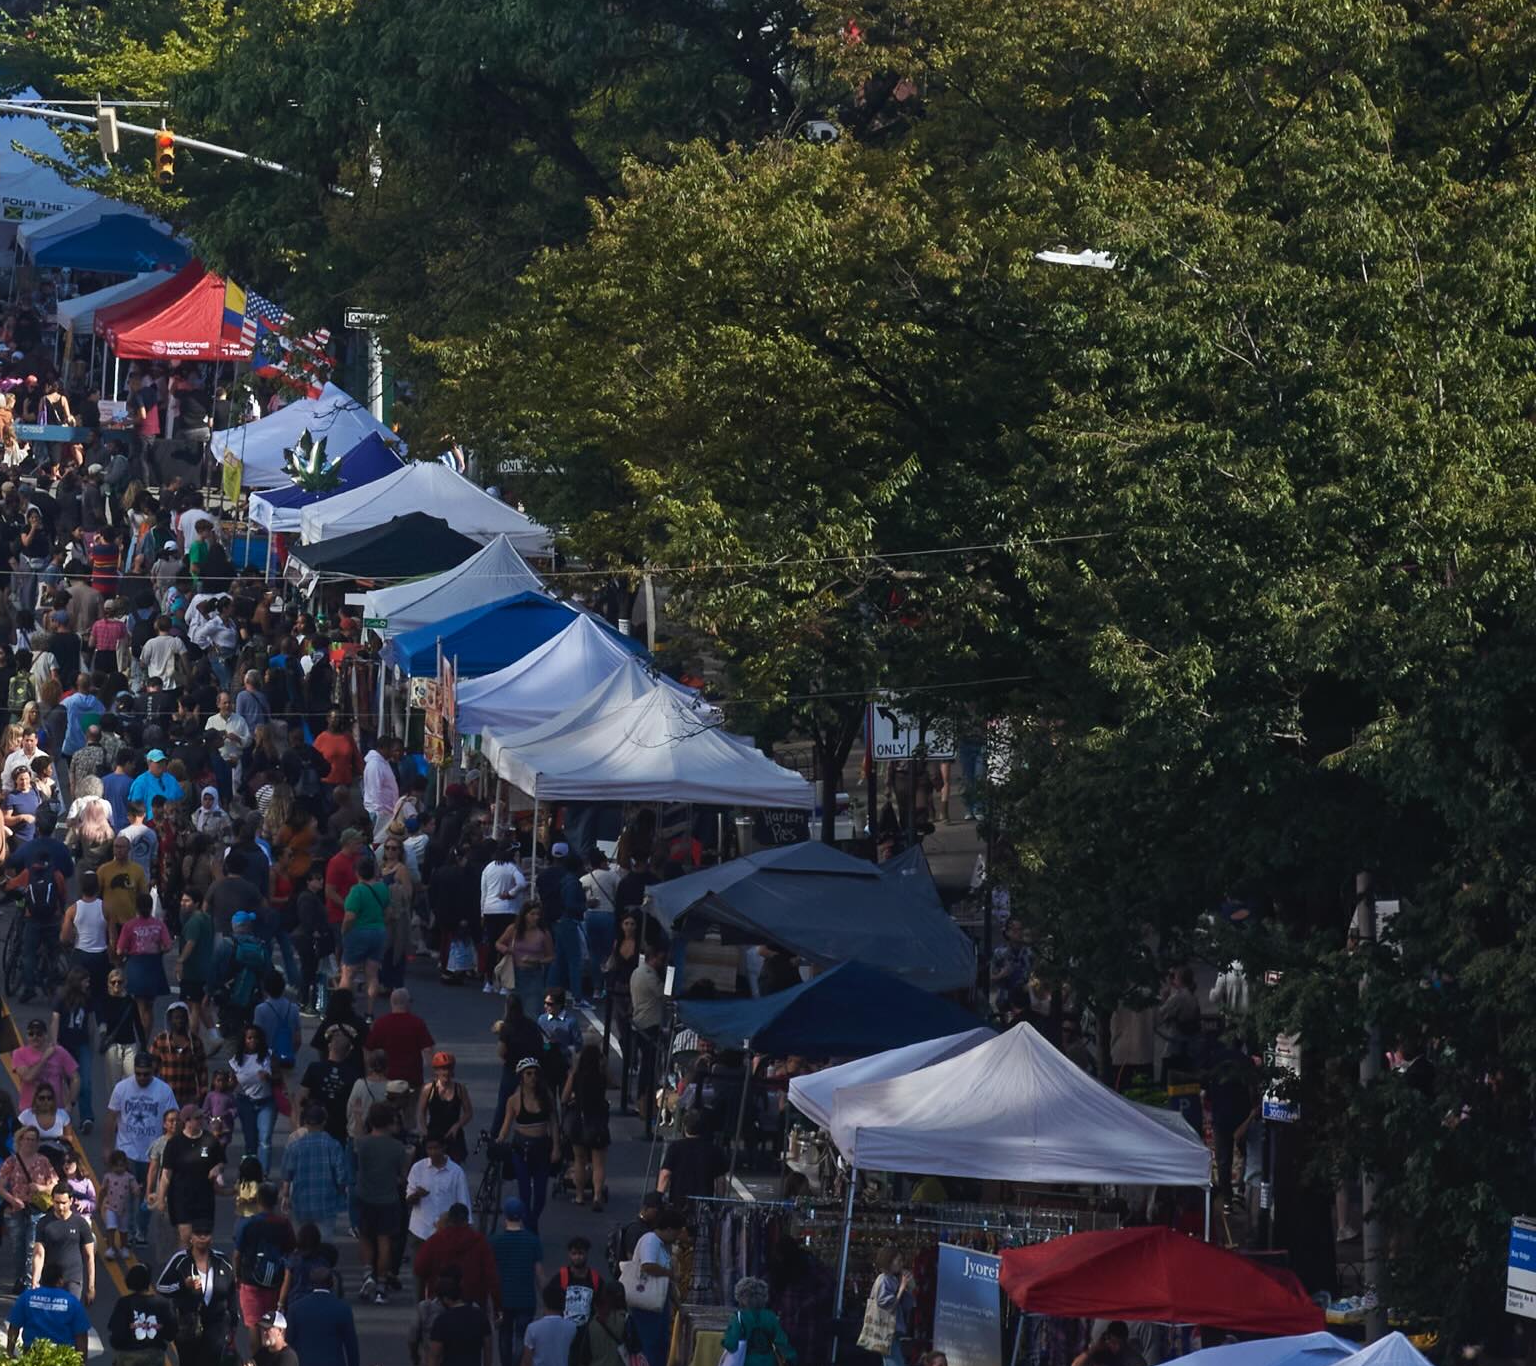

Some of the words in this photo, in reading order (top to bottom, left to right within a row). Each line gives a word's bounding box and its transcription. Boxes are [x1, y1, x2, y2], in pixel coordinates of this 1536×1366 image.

[2, 197, 36, 207] FOUR
[40, 201, 64, 212] THE
[166, 341, 184, 349] Well
[186, 341, 210, 350] Cornell
[166, 348, 200, 356] Medicine
[877, 743, 905, 756] ONLY
